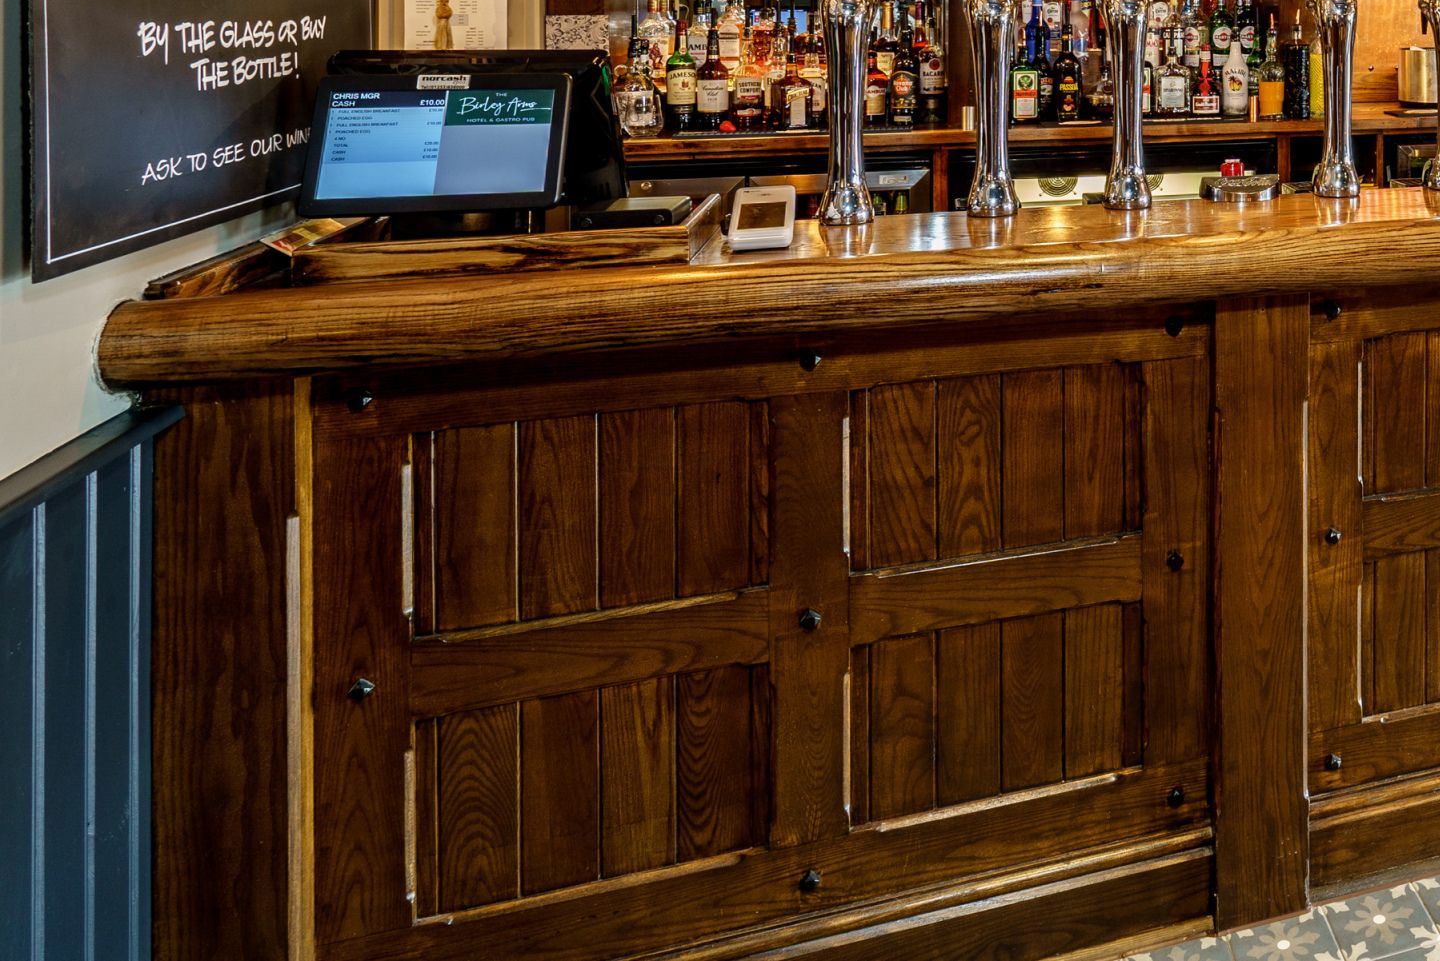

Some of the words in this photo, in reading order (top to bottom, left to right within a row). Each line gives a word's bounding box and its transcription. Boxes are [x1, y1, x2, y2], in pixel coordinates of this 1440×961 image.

[137, 22, 168, 65] BY
[175, 20, 215, 53] THE
[220, 20, 275, 48] GLASS
[278, 20, 298, 46] OR
[300, 16, 326, 40] BUY
[190, 58, 229, 91] THE
[231, 52, 300, 85] BOTTLE!
[457, 96, 505, 115] Birley
[508, 97, 540, 116] Arms
[142, 156, 183, 186] ASK
[186, 153, 207, 172] TO
[213, 143, 246, 168] SEE
[250, 132, 283, 157] OUR
